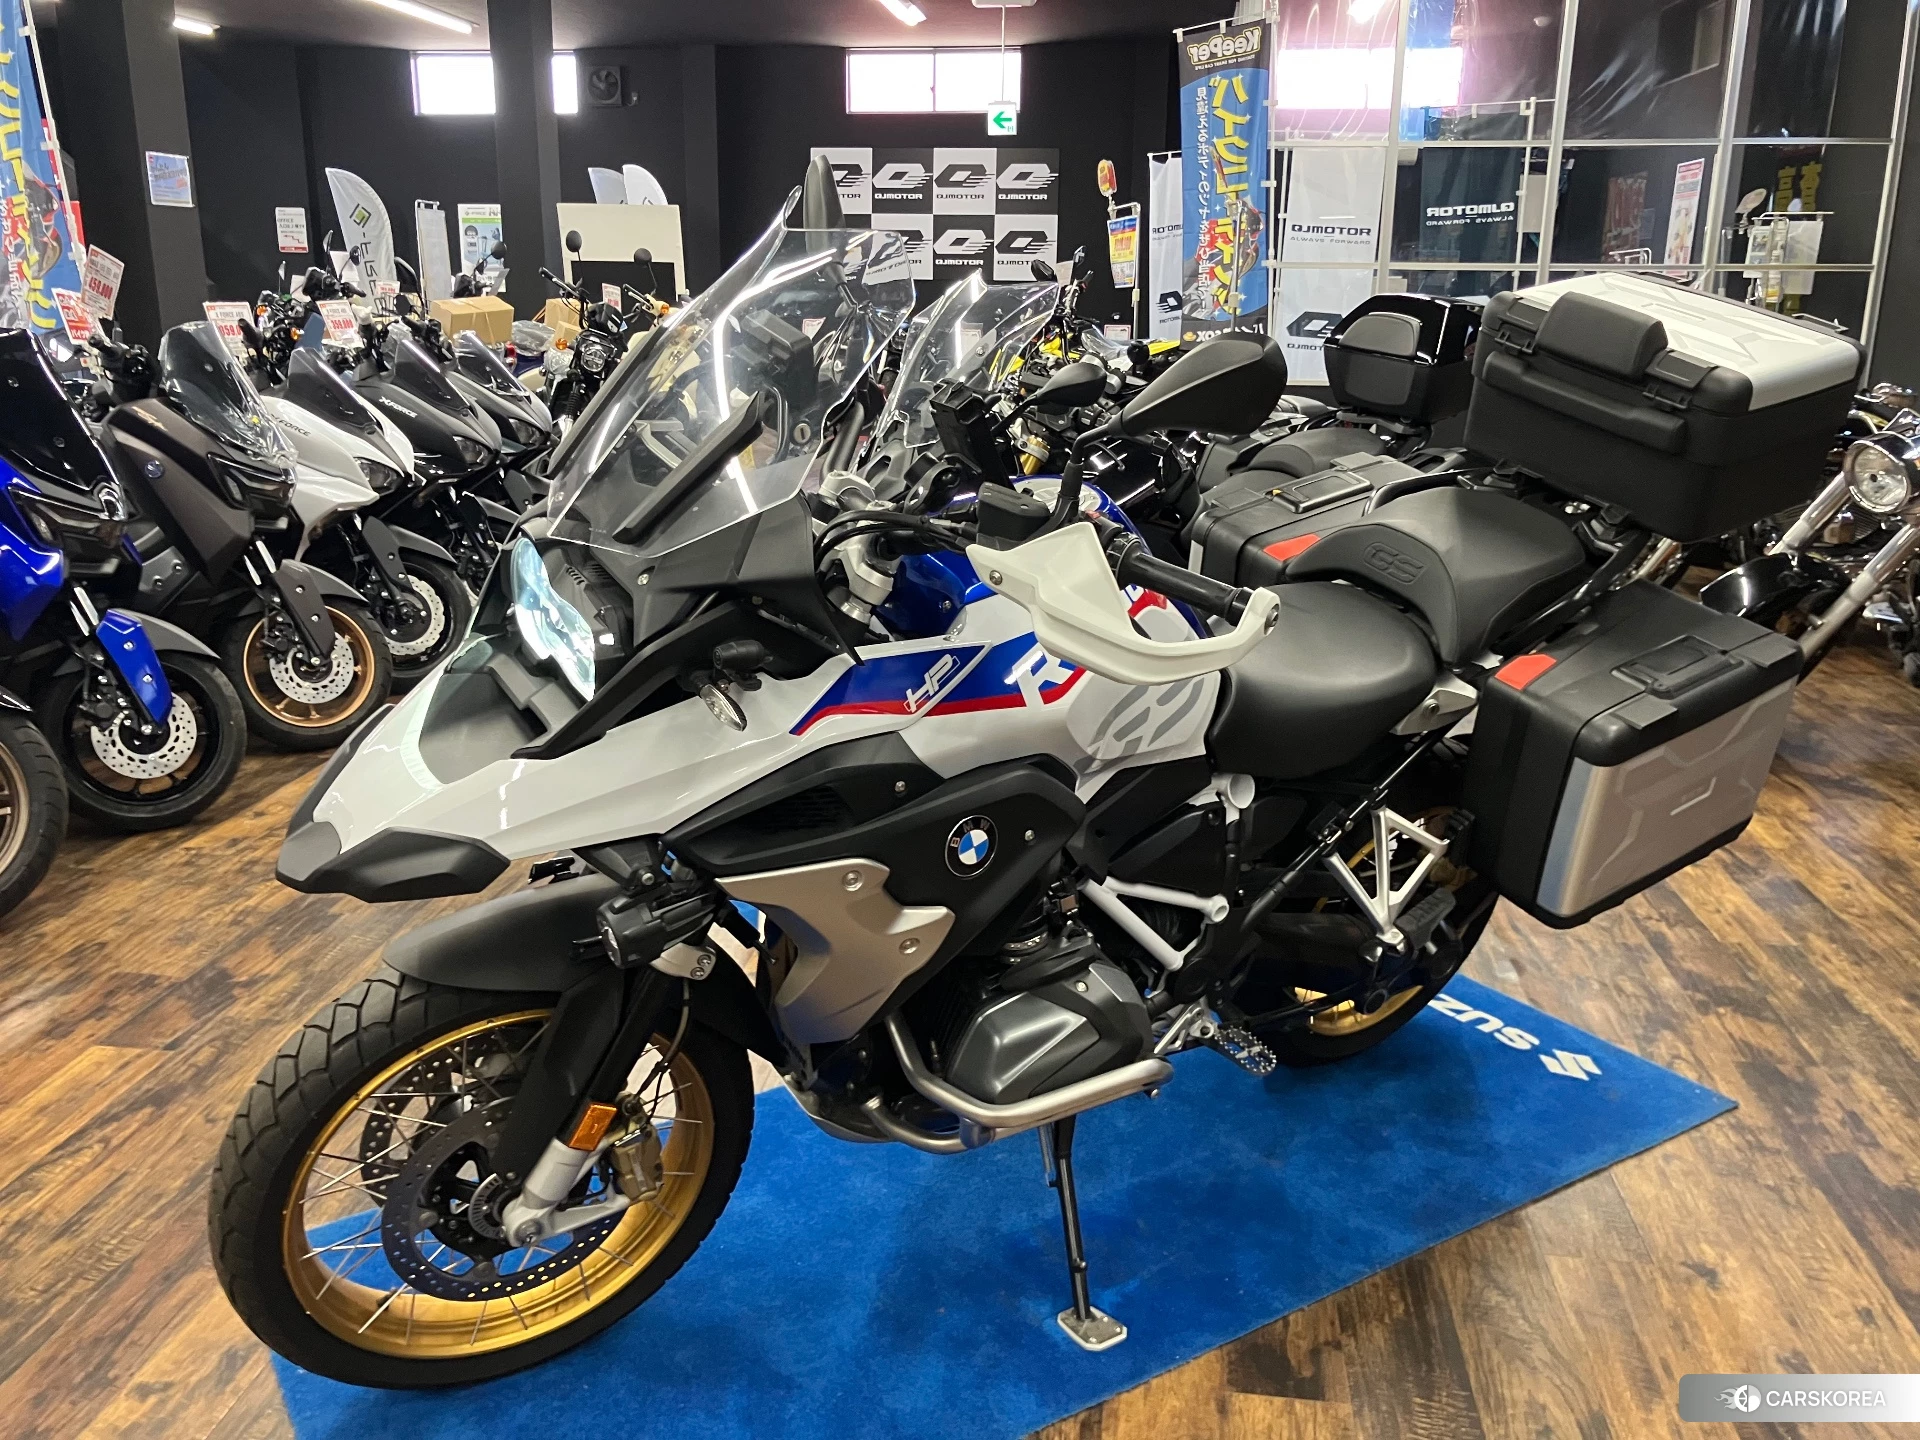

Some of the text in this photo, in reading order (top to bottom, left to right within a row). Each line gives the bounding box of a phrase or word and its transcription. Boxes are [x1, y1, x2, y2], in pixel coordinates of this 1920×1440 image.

[1291, 224, 1372, 236] QJMOTOR
[1363, 542, 1424, 580] GS
[905, 654, 955, 713] HP
[950, 819, 991, 848] BMW
